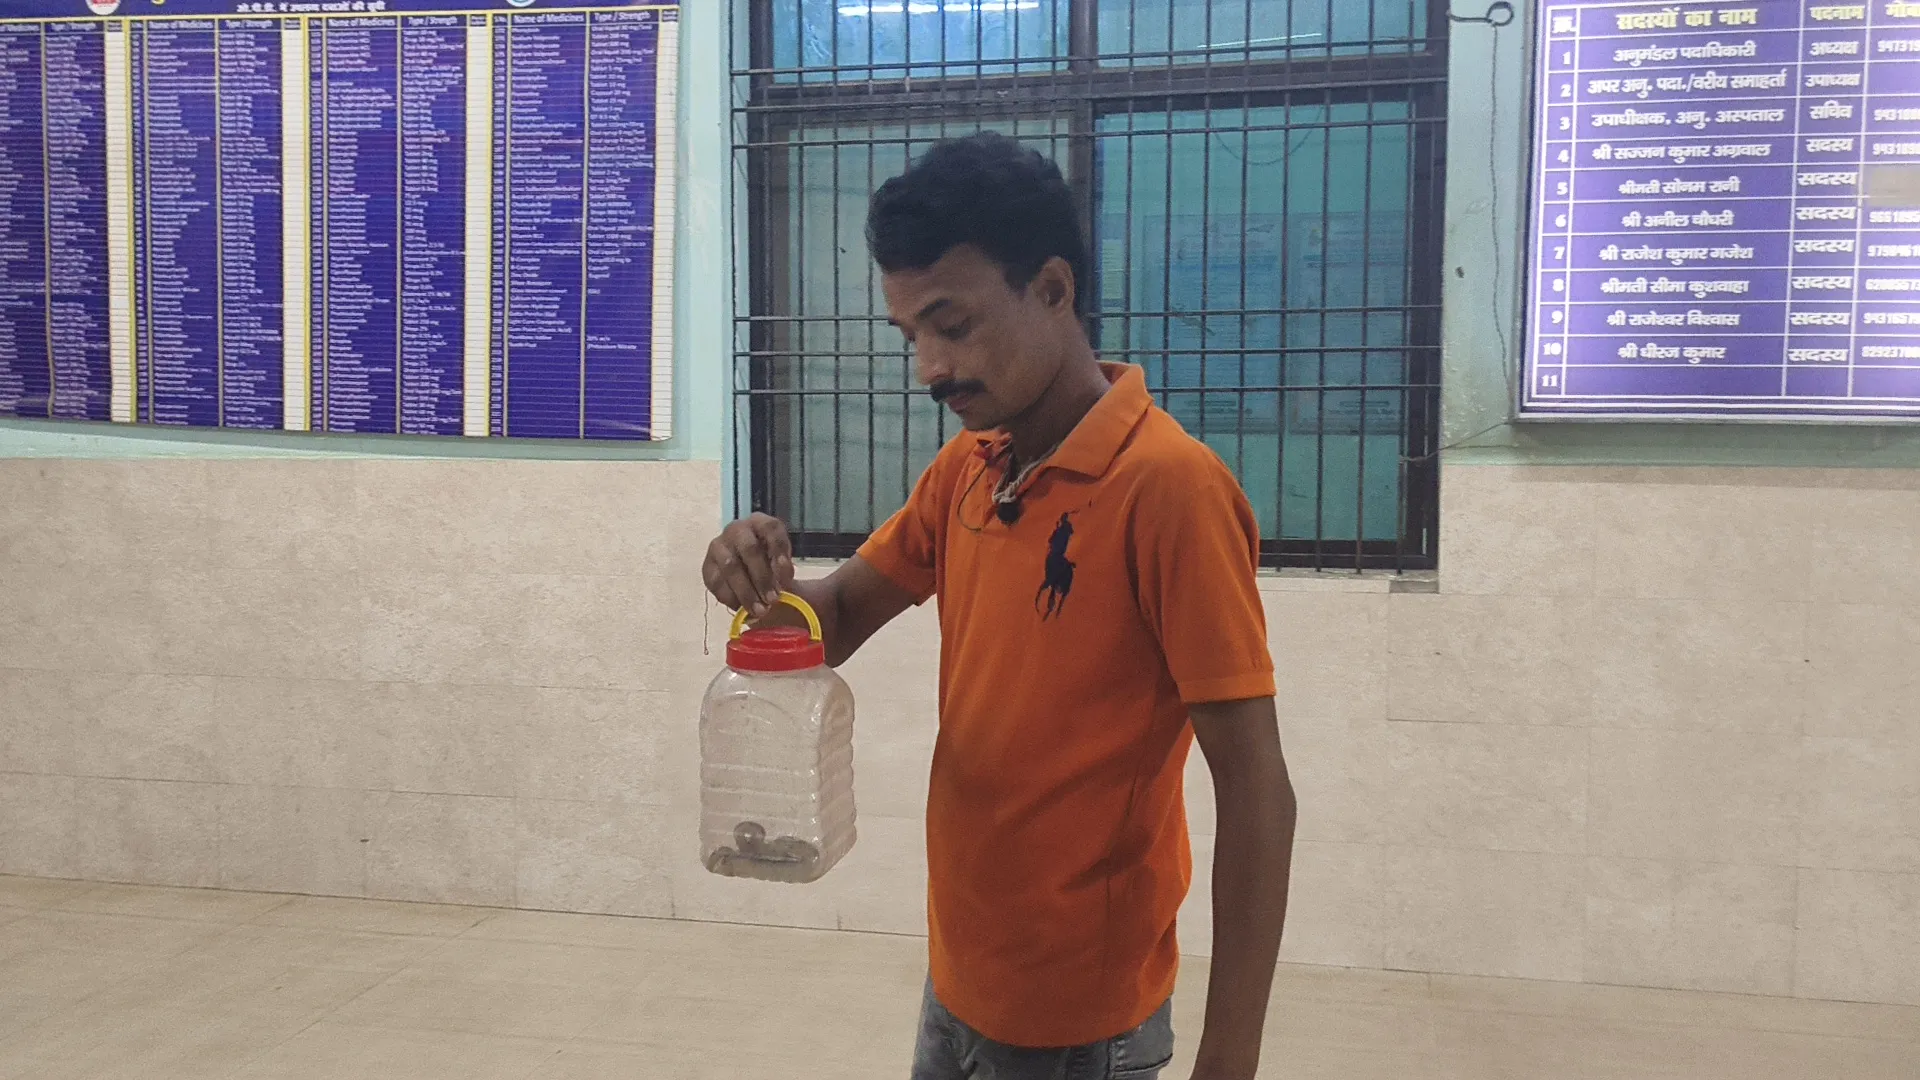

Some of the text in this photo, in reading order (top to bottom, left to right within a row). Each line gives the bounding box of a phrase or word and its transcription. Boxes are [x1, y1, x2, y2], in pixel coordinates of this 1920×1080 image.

[1685, 9, 1712, 26] का
[1719, 7, 1757, 25] नाम
[1810, 4, 1864, 21] पदनाम
[1563, 53, 1570, 64] 1
[1560, 85, 1571, 97] 2
[1560, 118, 1570, 131] 3
[1806, 138, 1853, 153] सदस्य
[1558, 149, 1569, 162] 4
[1798, 171, 1857, 186] सदस्य
[1556, 182, 1568, 195] 5
[1796, 206, 1856, 221] सदस्य
[1555, 214, 1567, 227] 6
[1794, 238, 1854, 254] सदस्य
[1554, 247, 1565, 260] 7
[1553, 279, 1564, 292] 8
[1792, 275, 1852, 290] सदस्य
[1551, 312, 1563, 324] 9
[1790, 312, 1850, 326] सदस्य
[1543, 343, 1561, 356] 10
[1788, 348, 1848, 363] सदस्य
[1542, 375, 1558, 388] 11
